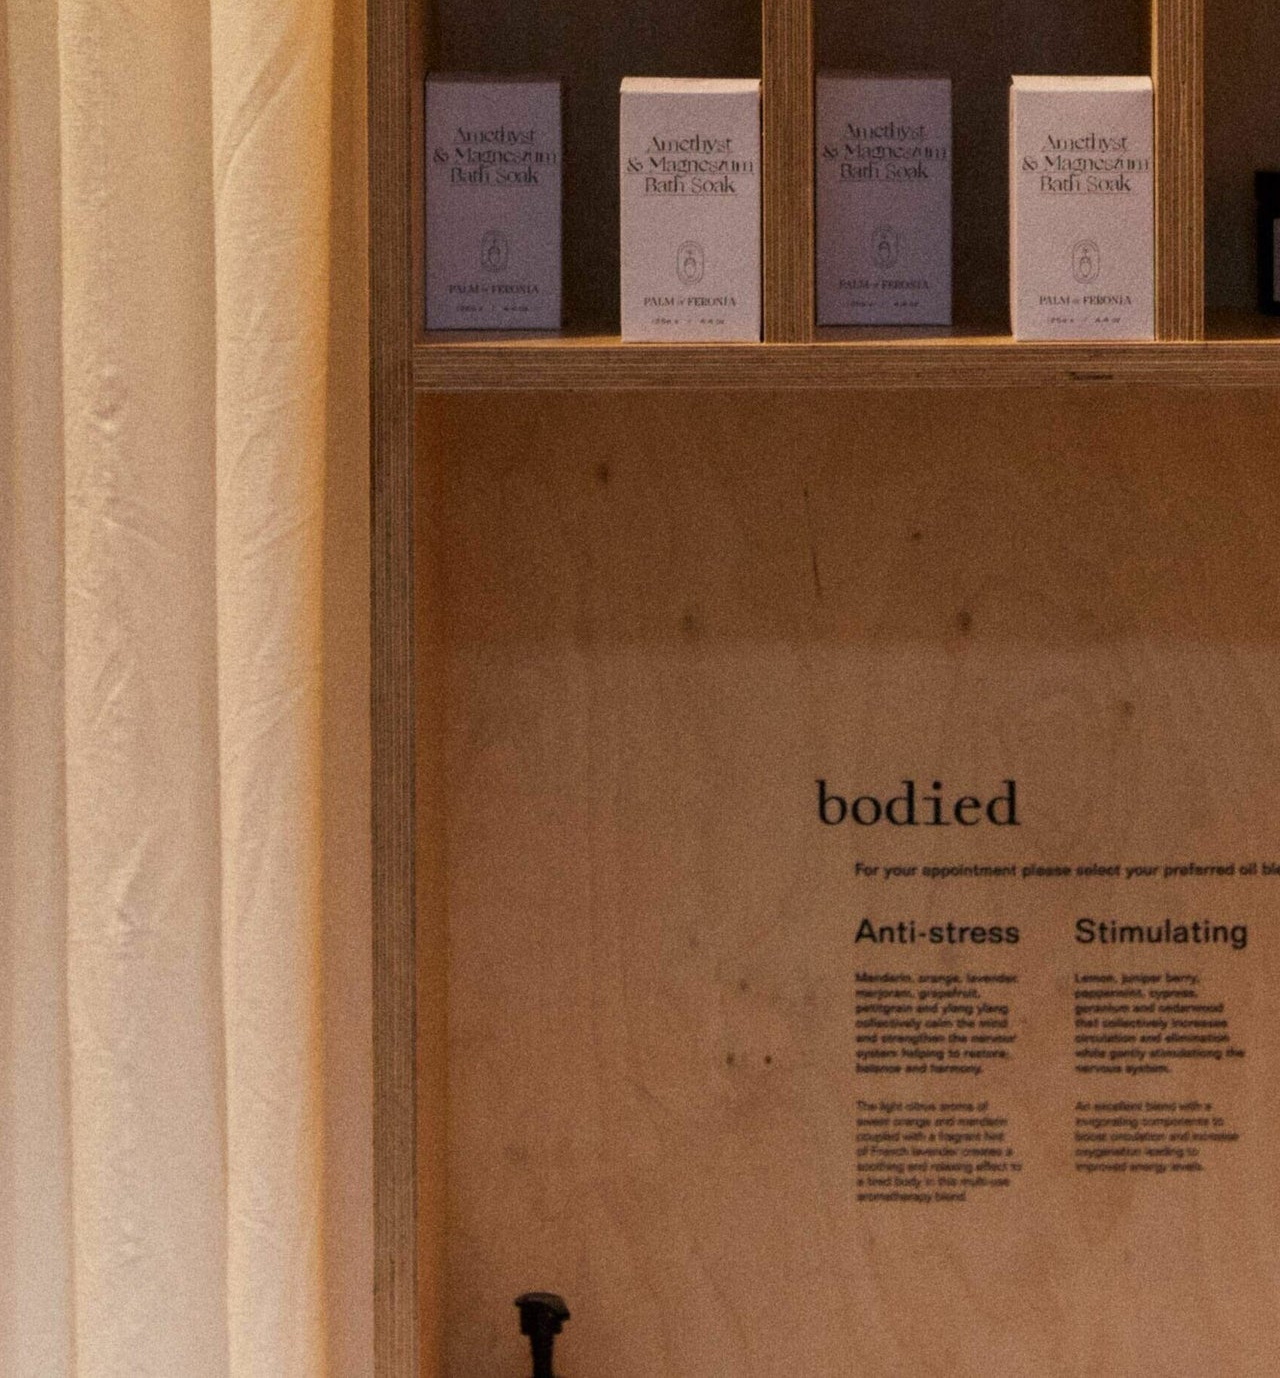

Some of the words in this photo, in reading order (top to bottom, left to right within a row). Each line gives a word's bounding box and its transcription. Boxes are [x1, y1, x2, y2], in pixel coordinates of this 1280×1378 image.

[453, 126, 536, 145] Amethyst
[841, 122, 924, 141] Amethyst
[646, 134, 733, 154] Amethyst
[1040, 133, 1127, 153] Amethyst
[433, 147, 449, 162] &
[823, 145, 838, 159] &
[627, 156, 643, 172] &
[840, 162, 879, 178] Bath
[886, 162, 928, 179] Soak
[1022, 155, 1038, 171] &
[451, 166, 489, 182] Bath
[496, 166, 538, 183] Soak
[645, 176, 684, 192] Bath
[691, 176, 735, 193] Soak
[1040, 175, 1080, 191] Bath
[1087, 175, 1131, 192] Soak
[815, 779, 1020, 826] bodied
[854, 862, 879, 875] For
[884, 865, 917, 879] your
[922, 862, 1016, 879] appointment
[1021, 862, 1072, 879] please
[1076, 862, 1121, 875] select
[1126, 865, 1158, 879] your
[1163, 862, 1235, 879] preferred
[1239, 862, 1258, 875] oil
[855, 919, 1020, 944] Anti-stress
[1075, 918, 1248, 949] Stimulating
